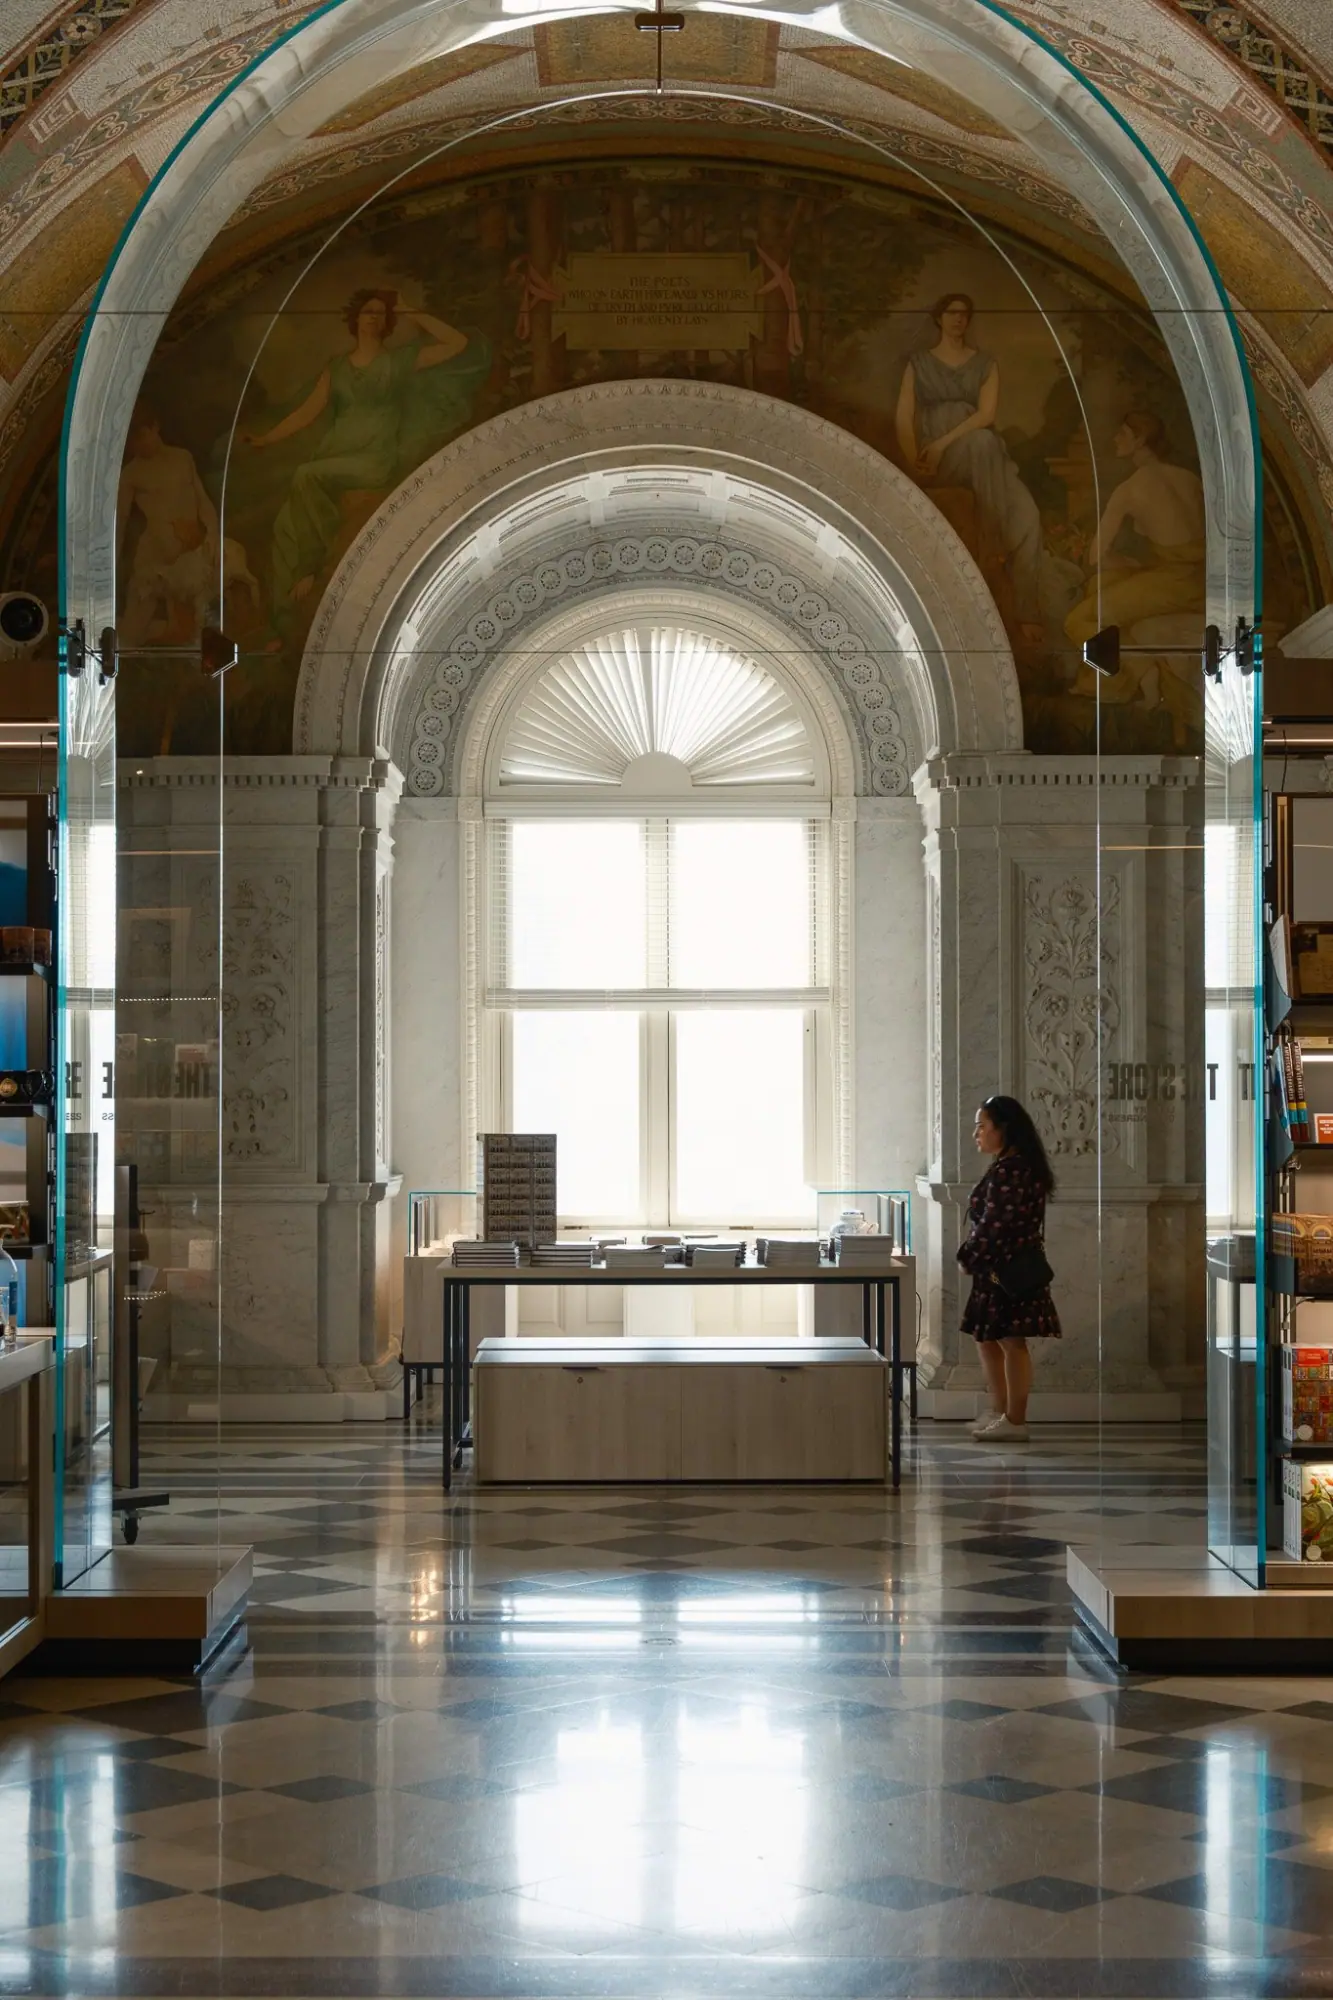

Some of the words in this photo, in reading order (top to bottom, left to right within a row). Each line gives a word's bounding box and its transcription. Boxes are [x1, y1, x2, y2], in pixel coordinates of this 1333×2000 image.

[630, 276, 650, 287] THE
[653, 276, 691, 288] POETS
[568, 289, 592, 300] WHO
[593, 289, 607, 299] ON
[610, 289, 642, 300] EARTH
[644, 289, 669, 300] HAVE
[717, 289, 749, 300] HEIRS
[639, 302, 657, 313] AND
[616, 315, 628, 326] BY
[631, 315, 684, 326] HEAVENLY
[684, 315, 709, 326] LAYS
